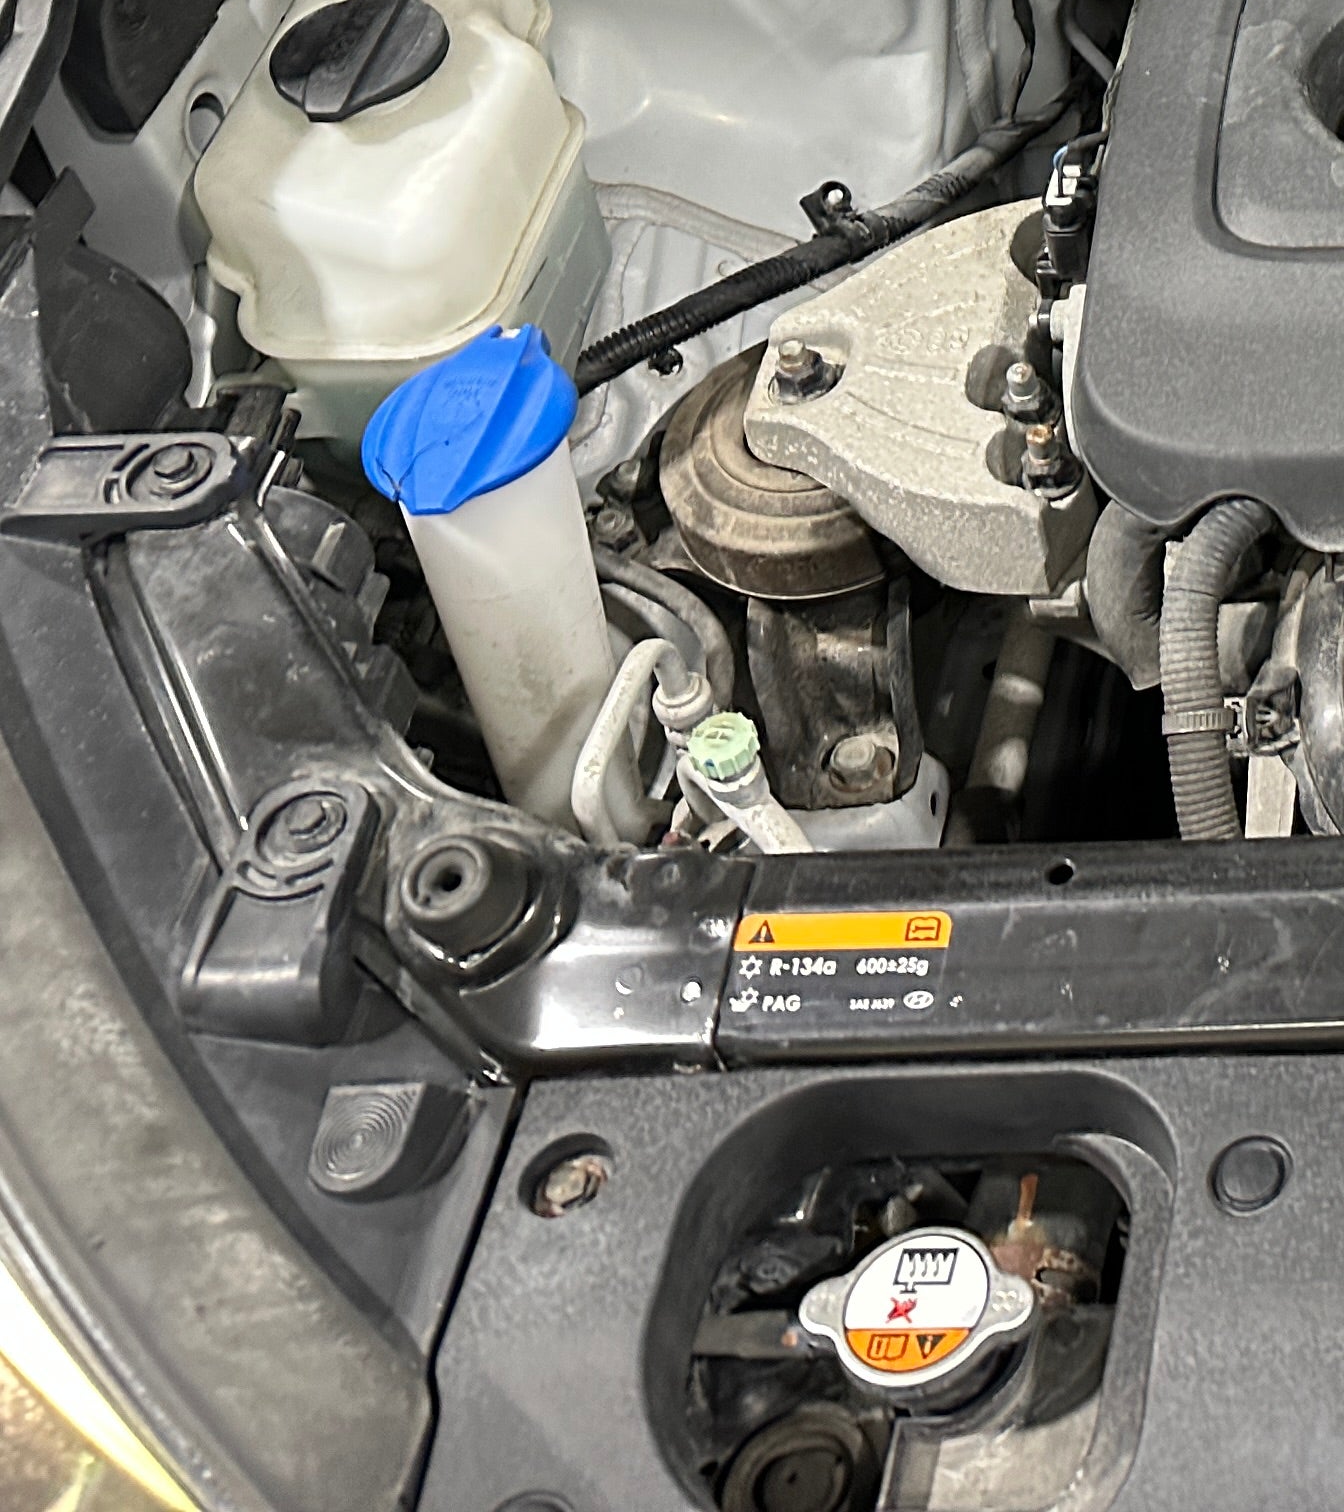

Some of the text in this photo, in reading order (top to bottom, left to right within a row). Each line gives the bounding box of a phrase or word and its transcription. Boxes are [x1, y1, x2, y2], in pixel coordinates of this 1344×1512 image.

[769, 957, 929, 977] R-134a 600±25g
[761, 996, 801, 1012] PAG
